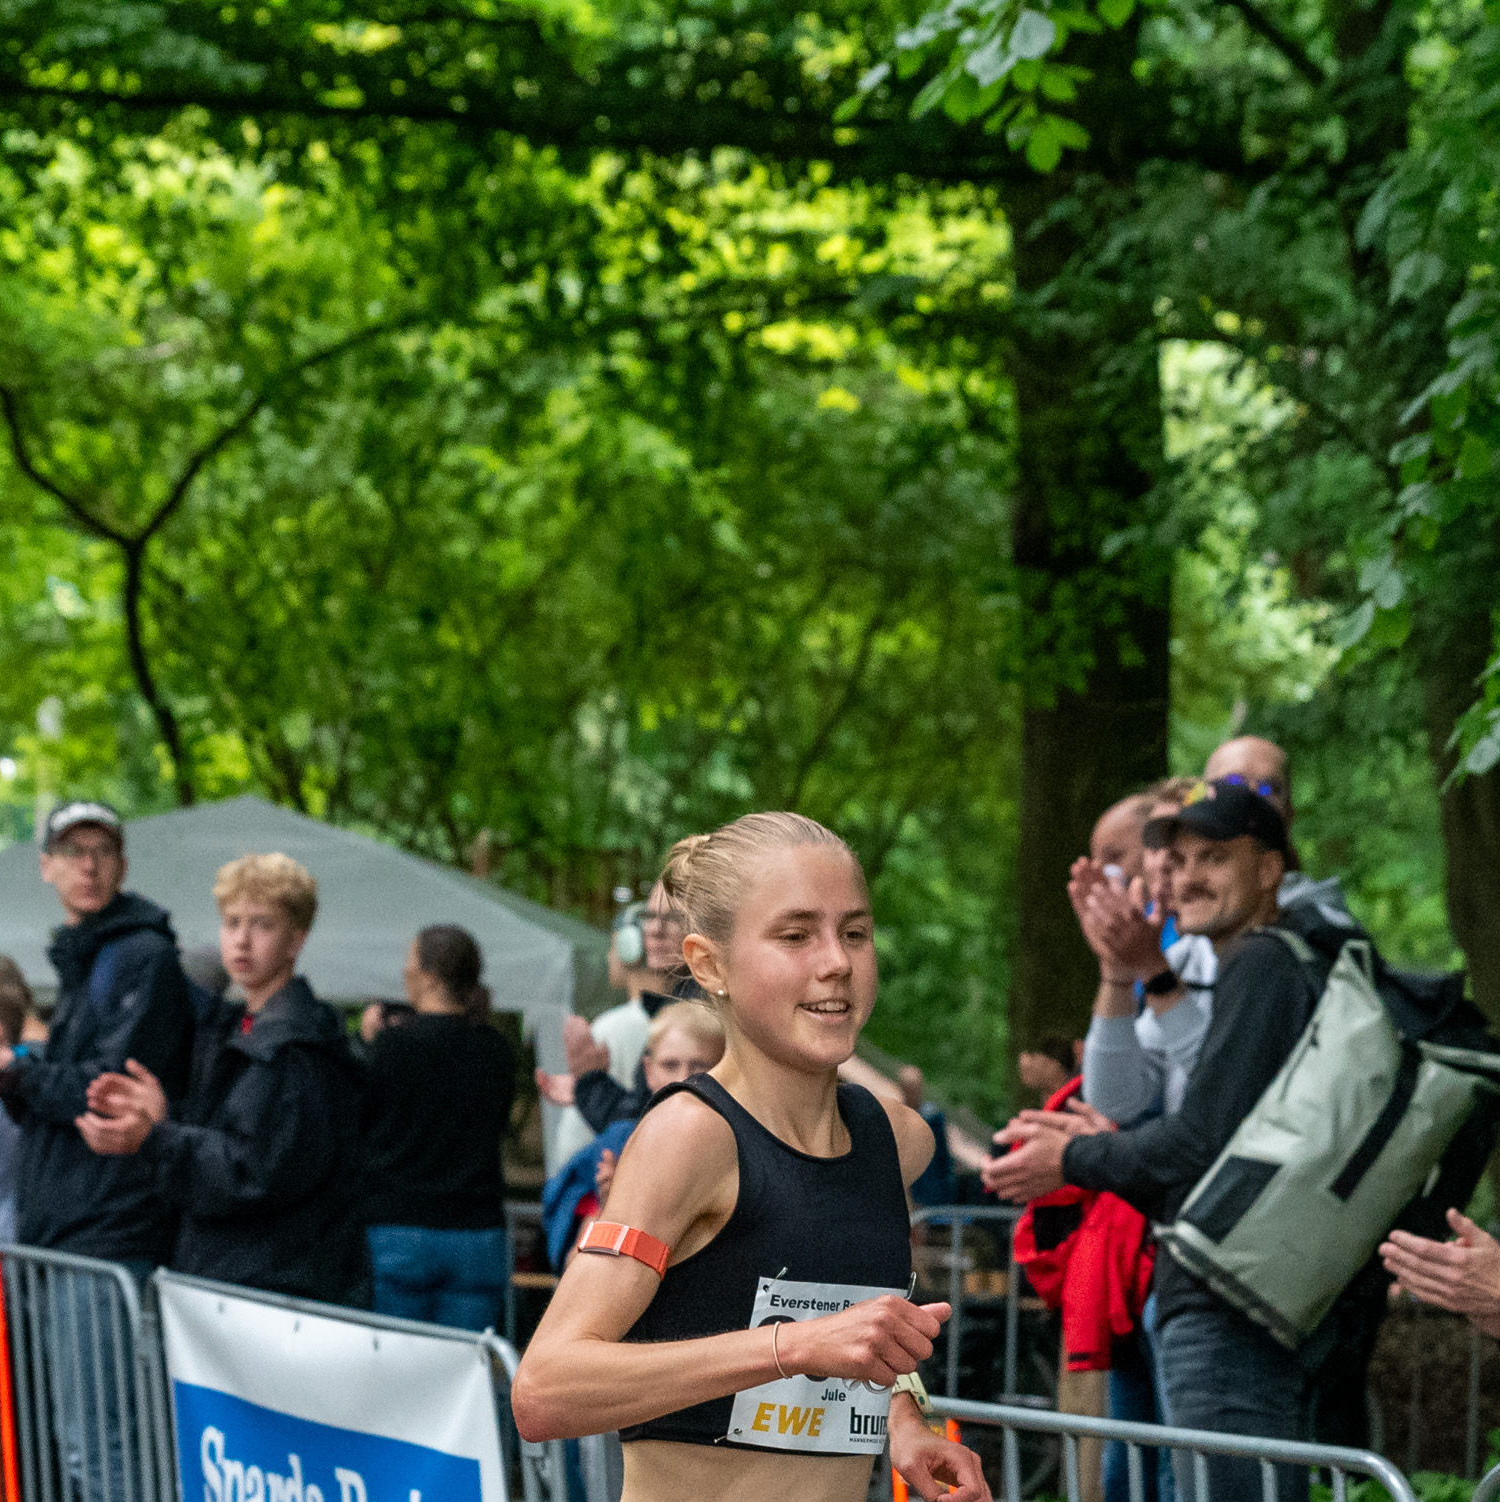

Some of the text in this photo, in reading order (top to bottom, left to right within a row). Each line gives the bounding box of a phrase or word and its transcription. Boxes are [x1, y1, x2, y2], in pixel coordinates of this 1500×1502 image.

[769, 1294, 841, 1312] Everstener
[820, 1388, 847, 1402] Jule
[751, 1402, 826, 1437] EWE
